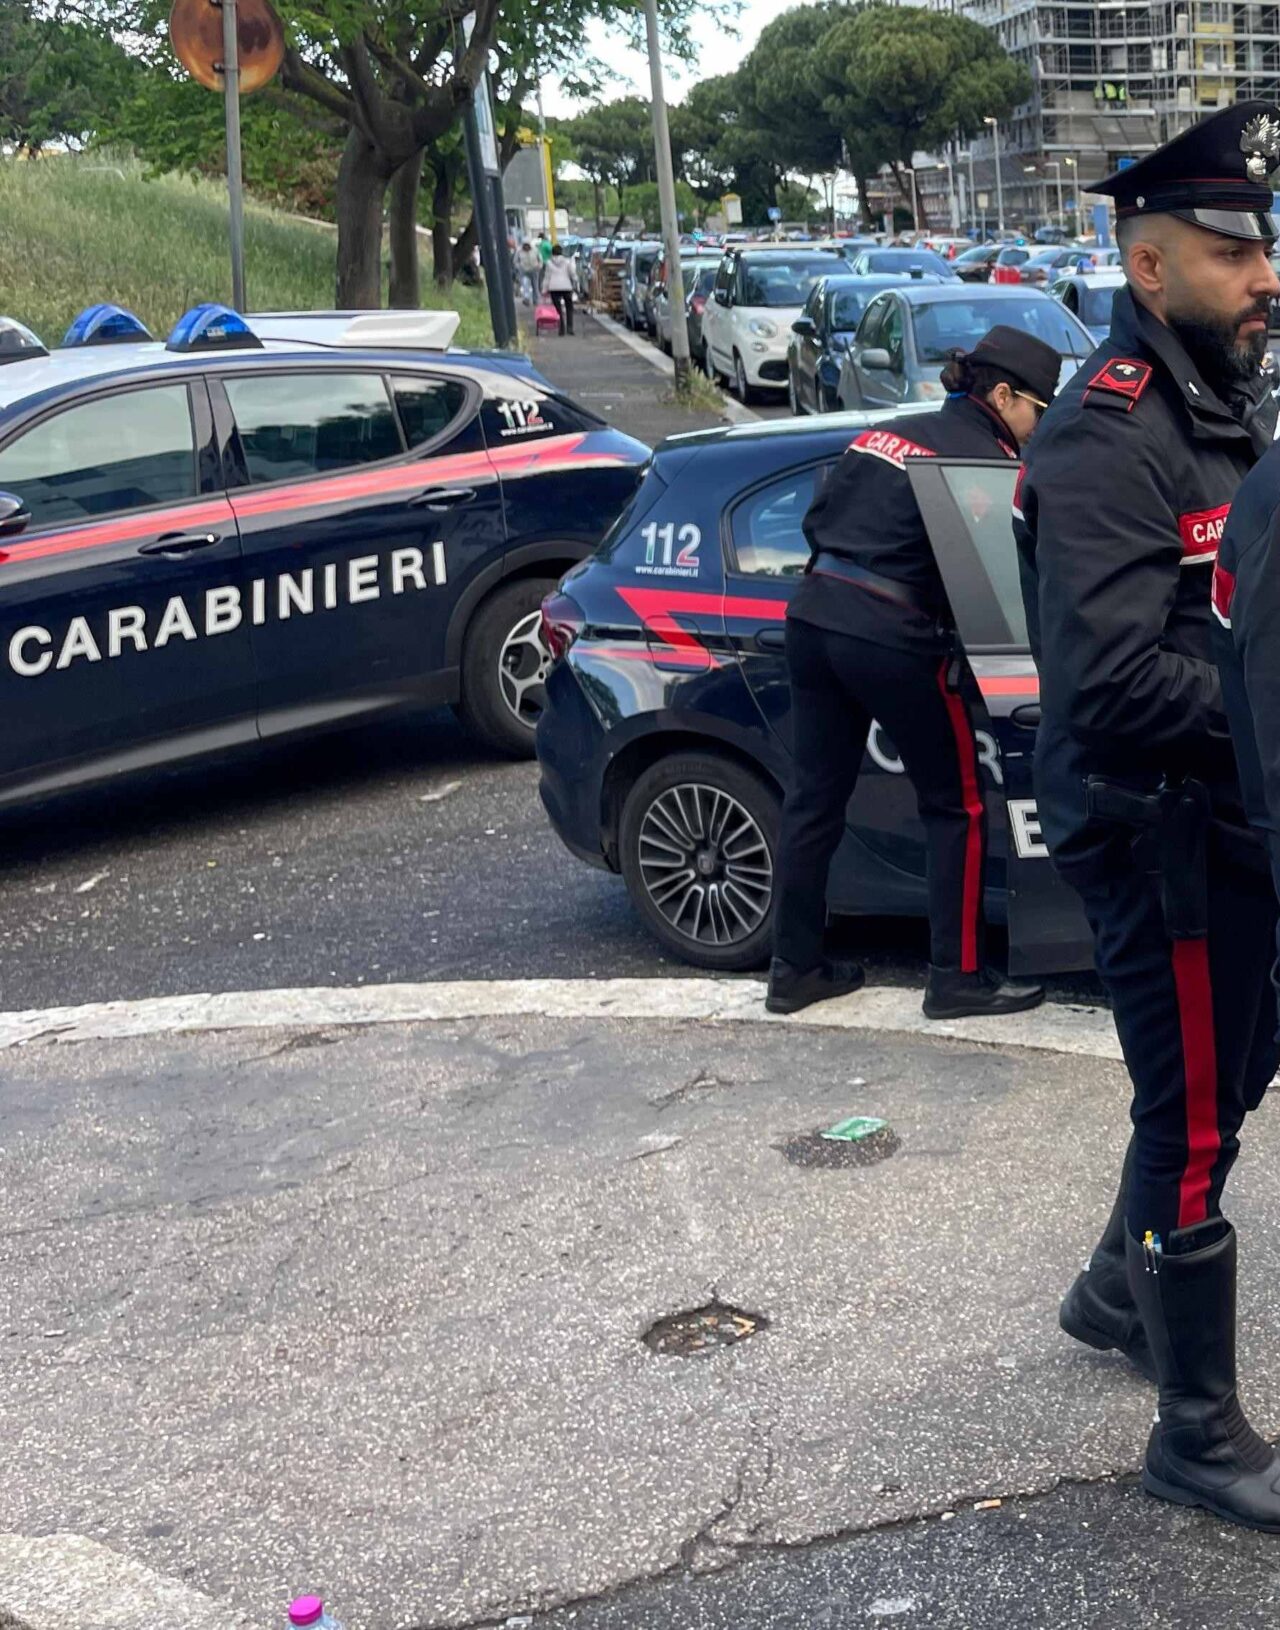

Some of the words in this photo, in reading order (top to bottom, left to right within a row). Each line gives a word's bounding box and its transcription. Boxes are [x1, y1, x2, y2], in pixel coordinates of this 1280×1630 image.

[497, 399, 544, 430] 112
[641, 521, 702, 567] 112
[1192, 516, 1228, 544] CAR
[8, 541, 448, 677] CARABINIERI
